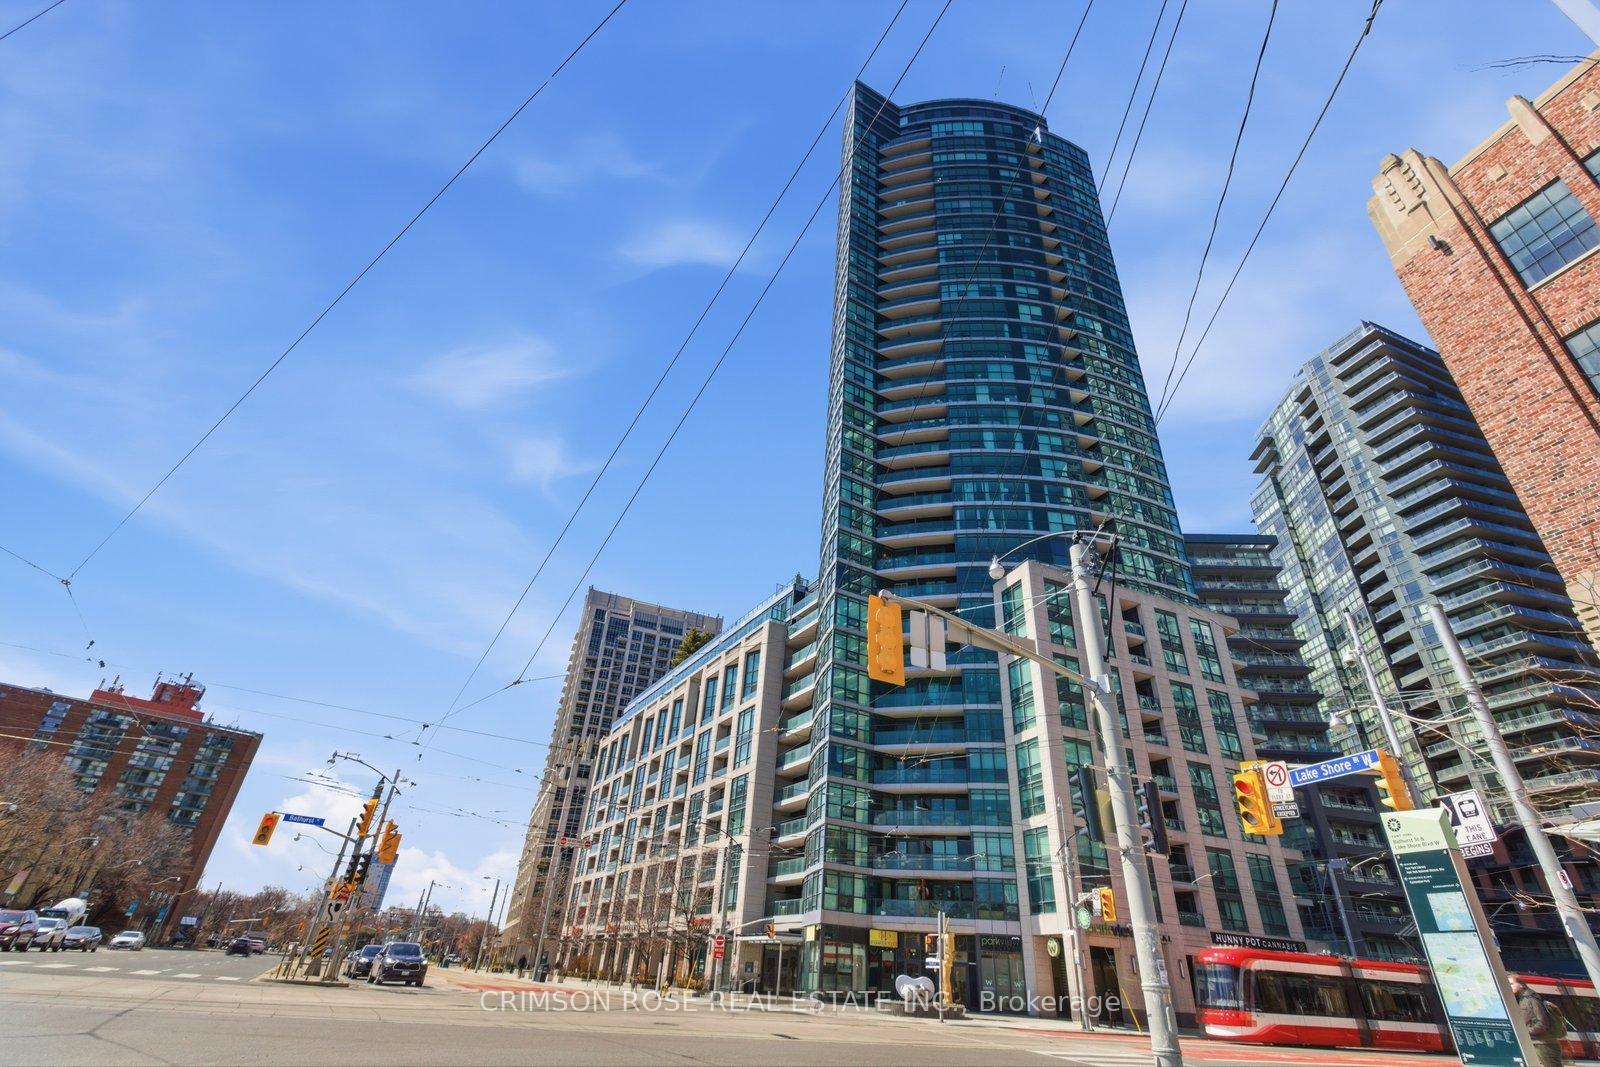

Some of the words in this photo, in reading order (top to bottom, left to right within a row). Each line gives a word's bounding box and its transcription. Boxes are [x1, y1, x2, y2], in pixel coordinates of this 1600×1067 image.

[1295, 768, 1318, 782] Lake
[1321, 762, 1351, 777] Shore
[1361, 754, 1373, 767] W
[1465, 823, 1482, 833] THIS
[1215, 933, 1243, 945] HUNNY
[1245, 937, 1260, 946] POT
[1262, 940, 1298, 951] CANNABIS
